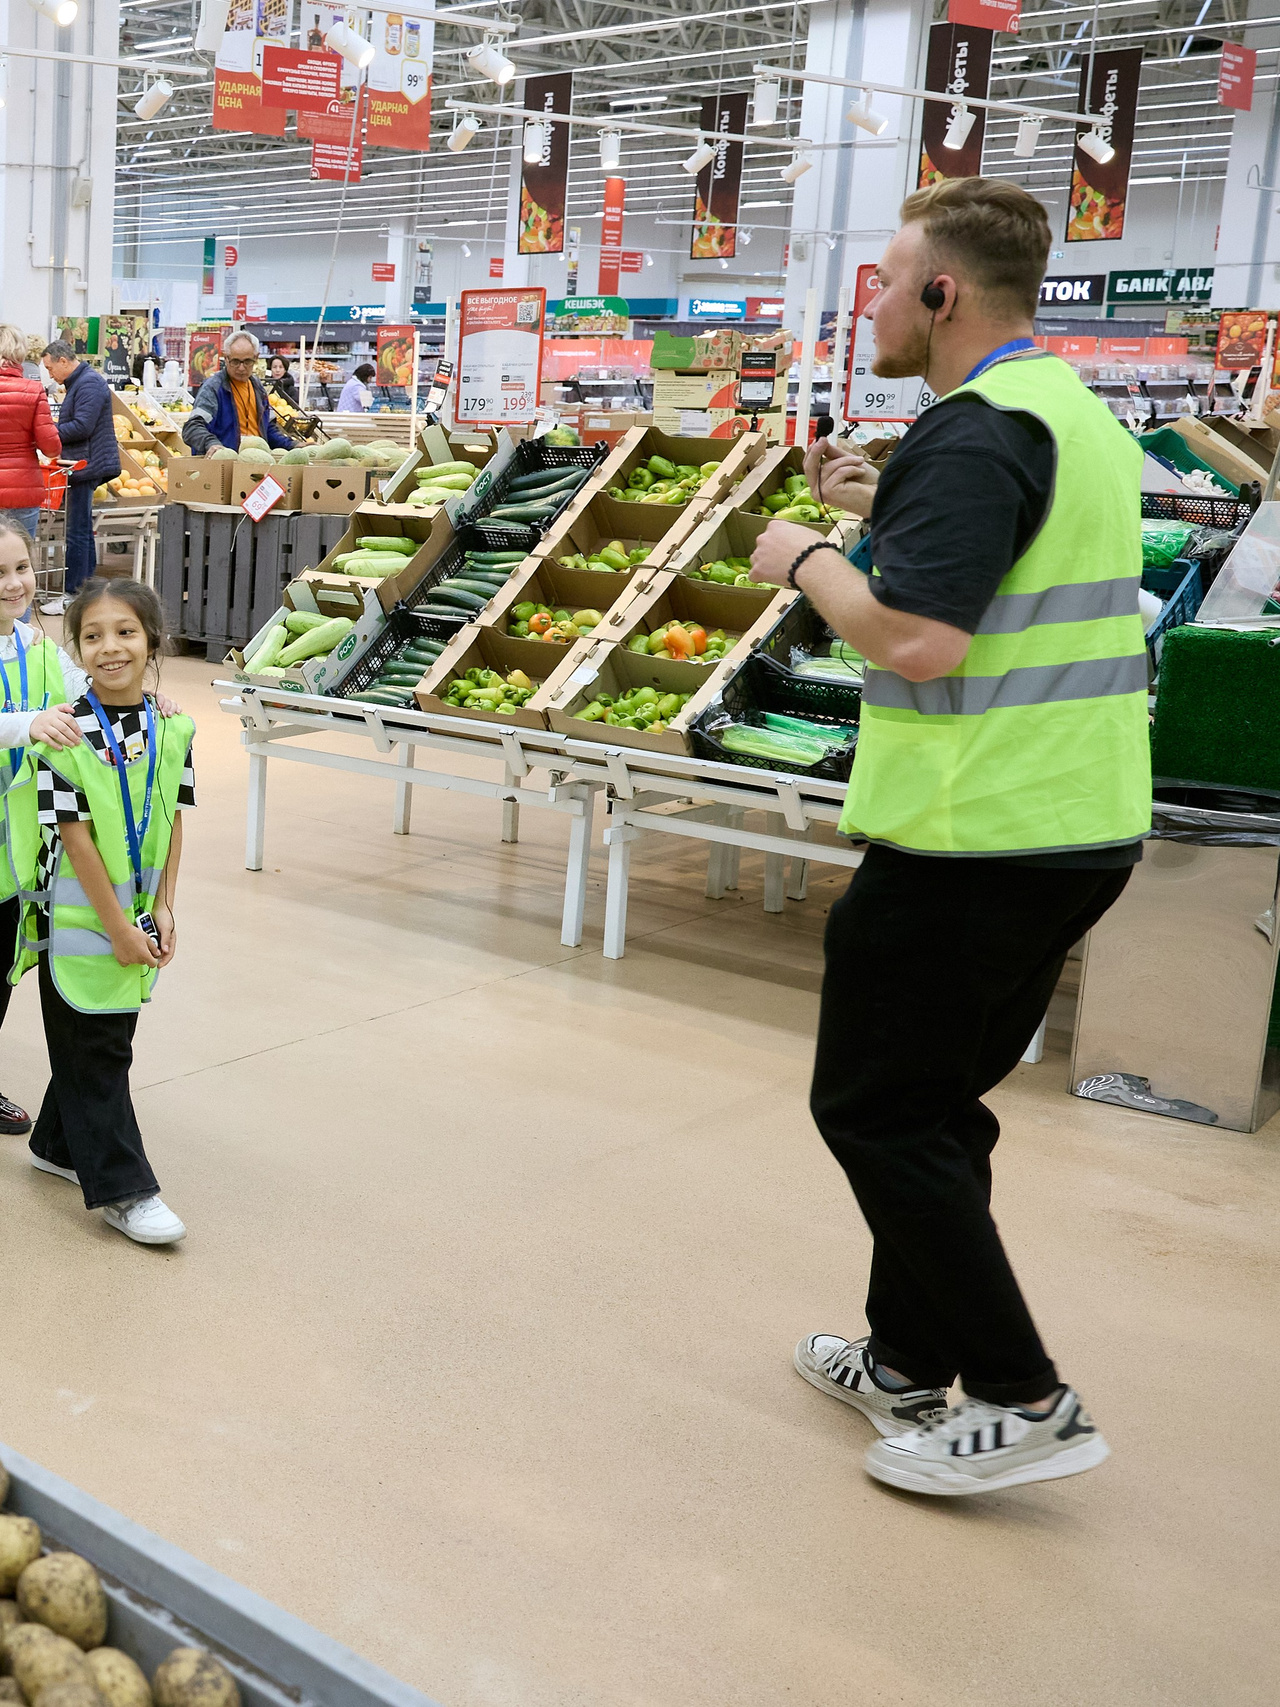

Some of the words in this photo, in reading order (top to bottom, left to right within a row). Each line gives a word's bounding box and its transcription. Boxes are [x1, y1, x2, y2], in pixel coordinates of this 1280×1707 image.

[407, 74, 418, 87] 99
[218, 80, 261, 96] УДАРНАЯ
[217, 95, 243, 109] ЦЕНА
[330, 104, 339, 113] 41
[371, 100, 408, 114] УДАРНАЯ
[370, 114, 392, 127] ЦЕНА
[538, 92, 555, 167] Конфты
[714, 111, 730, 179] Конфты
[1038, 281, 1091, 301] ТОК
[1116, 277, 1169, 293] БАНК
[480, 296, 517, 304] ВЫГОДНОЕ
[564, 299, 605, 309] КЕШБЭК
[379, 329, 400, 338] Сочно!
[464, 398, 486, 411] 179
[503, 397, 526, 411] 199
[865, 393, 886, 408] 99
[476, 475, 491, 494] РОСТ
[339, 638, 355, 658] РОСТ
